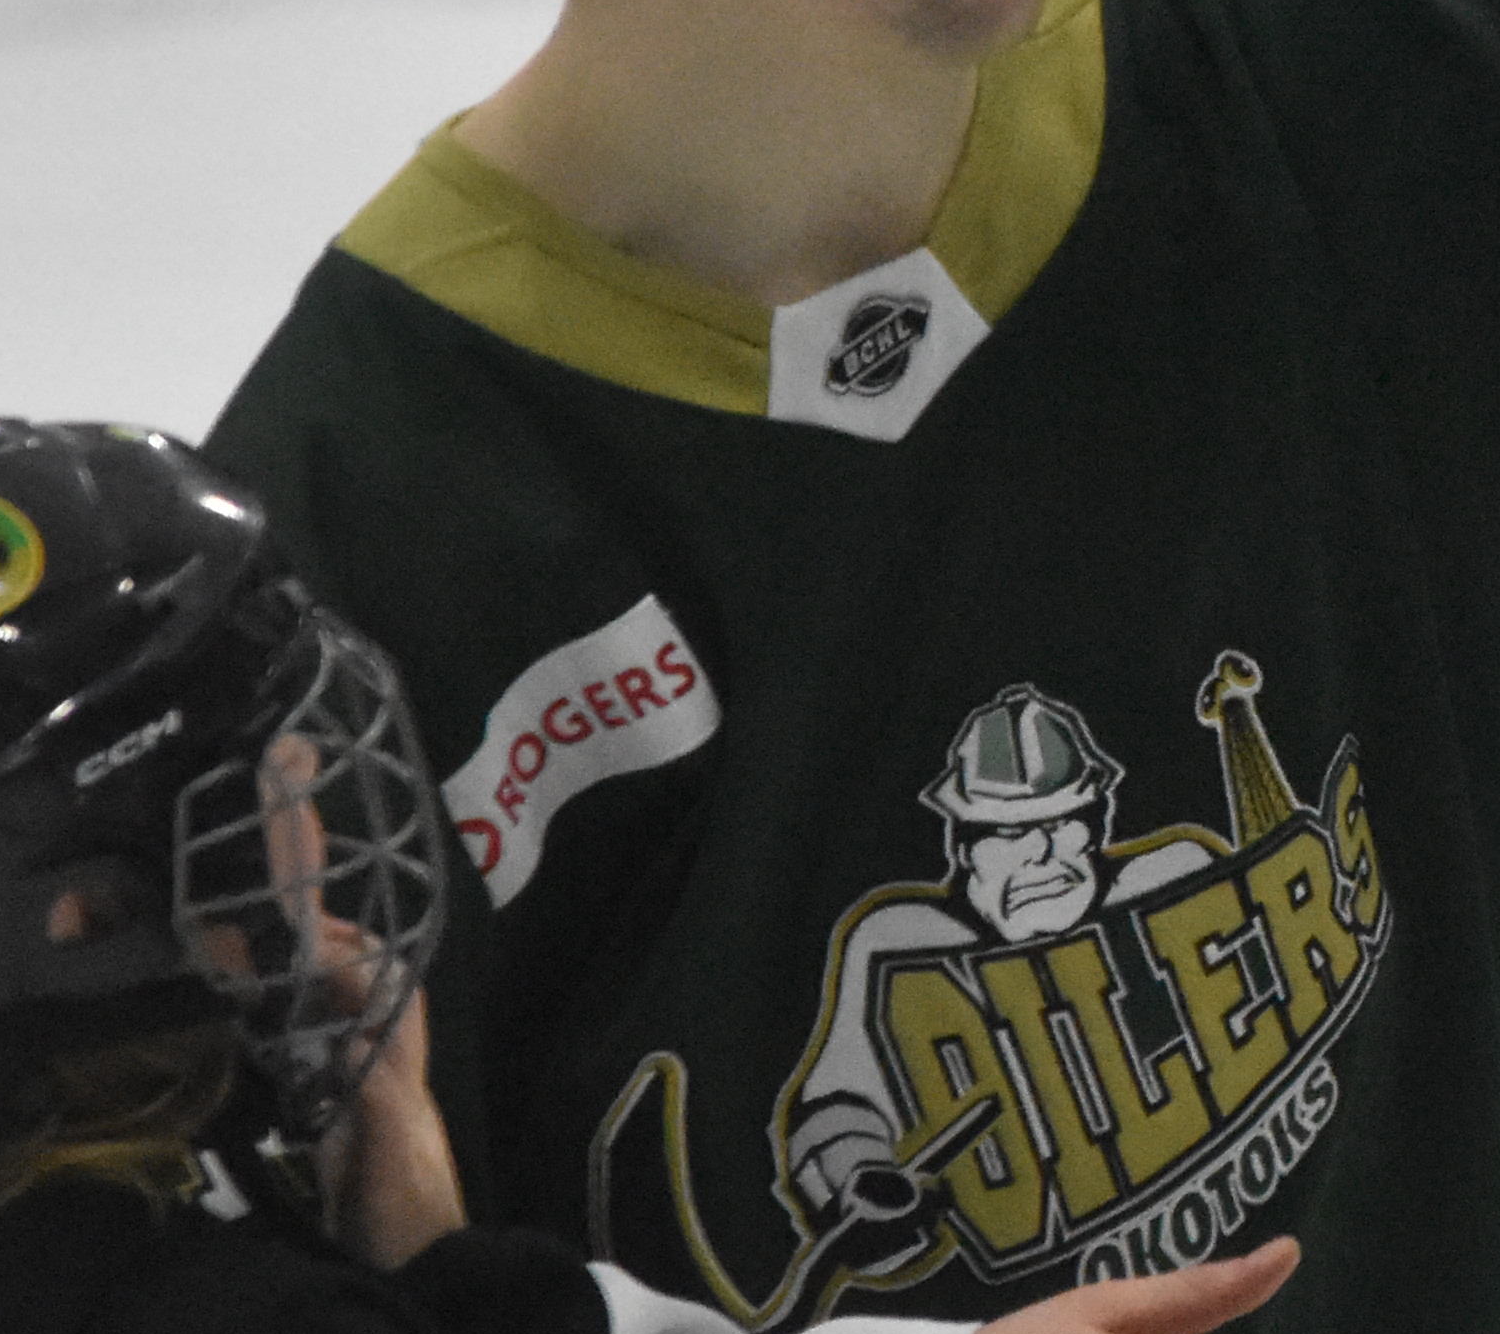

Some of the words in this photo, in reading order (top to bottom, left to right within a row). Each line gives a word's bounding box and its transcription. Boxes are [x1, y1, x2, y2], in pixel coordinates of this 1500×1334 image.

[76, 708, 183, 788] CCM
[878, 747, 1390, 1255] OILERS
[1078, 1057, 1340, 1285] OKOTOKS
